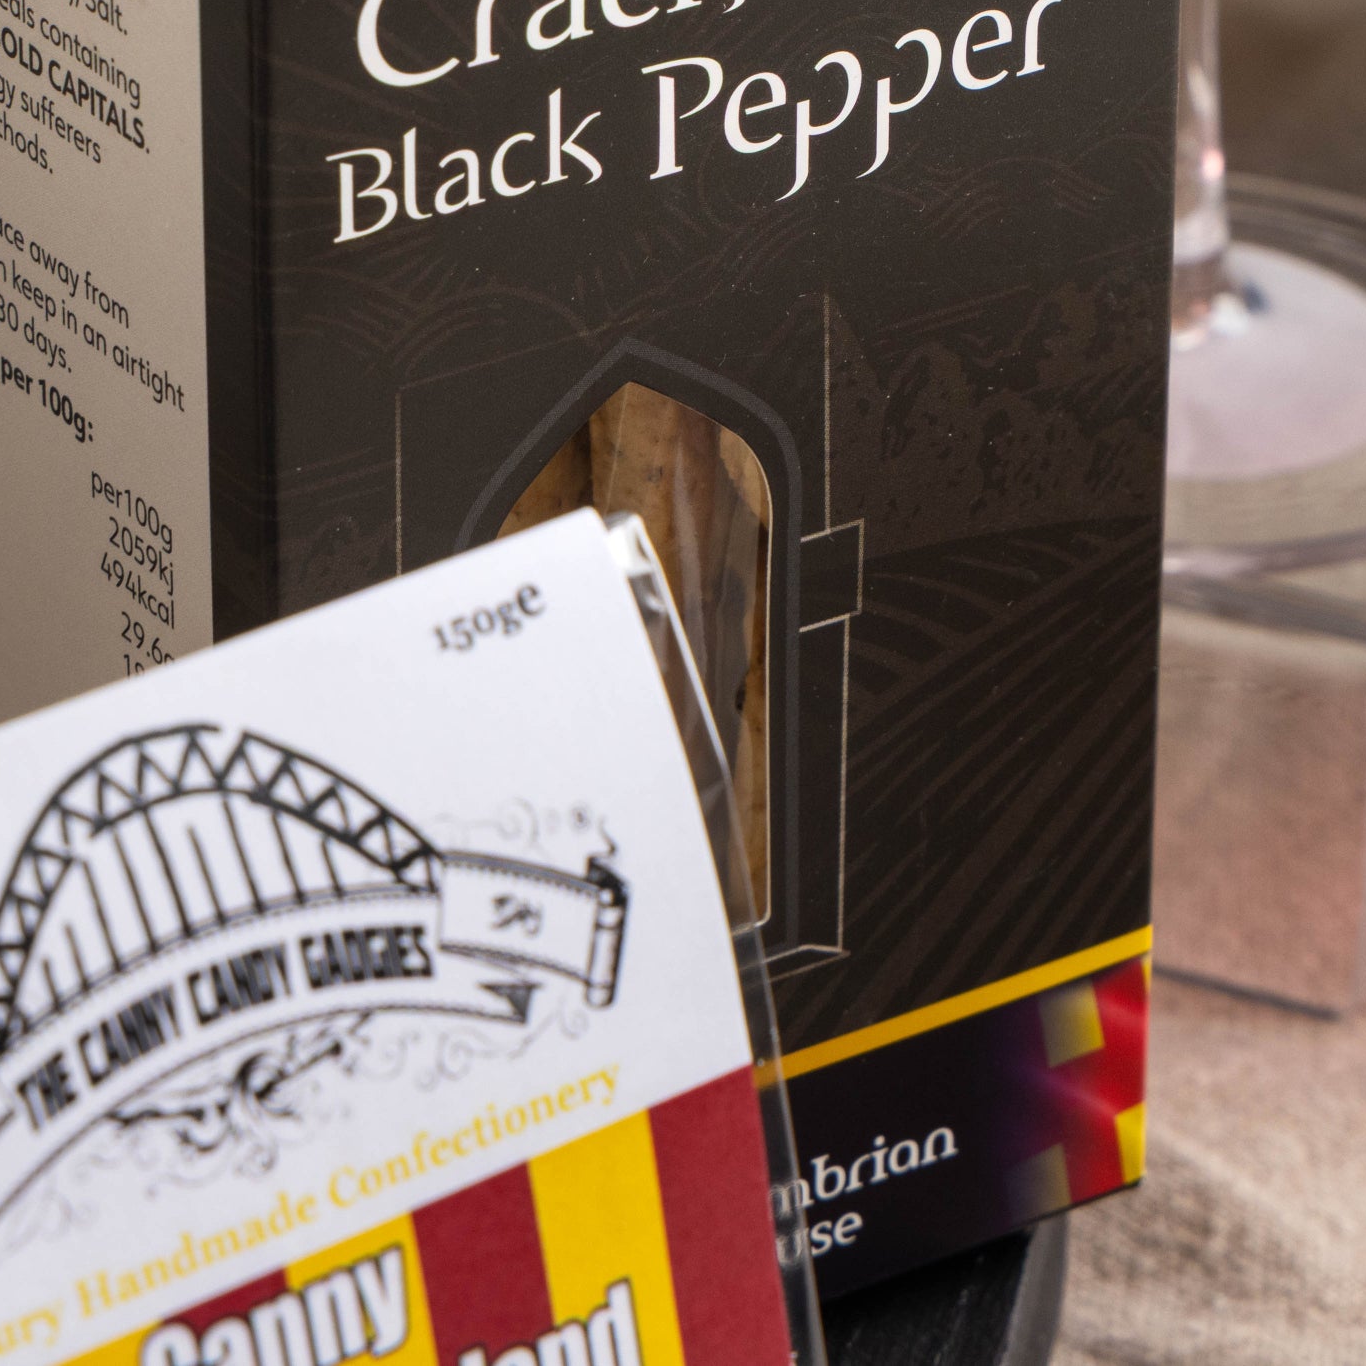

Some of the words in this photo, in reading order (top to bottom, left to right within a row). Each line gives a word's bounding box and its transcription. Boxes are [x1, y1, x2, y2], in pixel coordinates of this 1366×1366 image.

[39, 17, 141, 111] containing
[47, 59, 150, 155] CAPITALS.
[20, 90, 102, 164] sufferers
[326, 87, 605, 244] Black
[29, 240, 80, 299] away
[83, 270, 130, 330] from
[11, 258, 57, 323] keep
[61, 298, 78, 335] in
[82, 323, 108, 357] an
[111, 344, 185, 413] airtight
[23, 315, 73, 374] days.
[0, 355, 34, 395] per
[37, 378, 94, 444] 100g:
[91, 470, 173, 555] per100g
[108, 515, 174, 597] 2059kj
[100, 551, 175, 630] 494kcal
[17, 1049, 78, 1129] THE
[77, 983, 182, 1088] CANNY
[186, 941, 292, 1026] CANDY
[74, 1191, 319, 1320] Handmade
[326, 1060, 623, 1208] Confectionery
